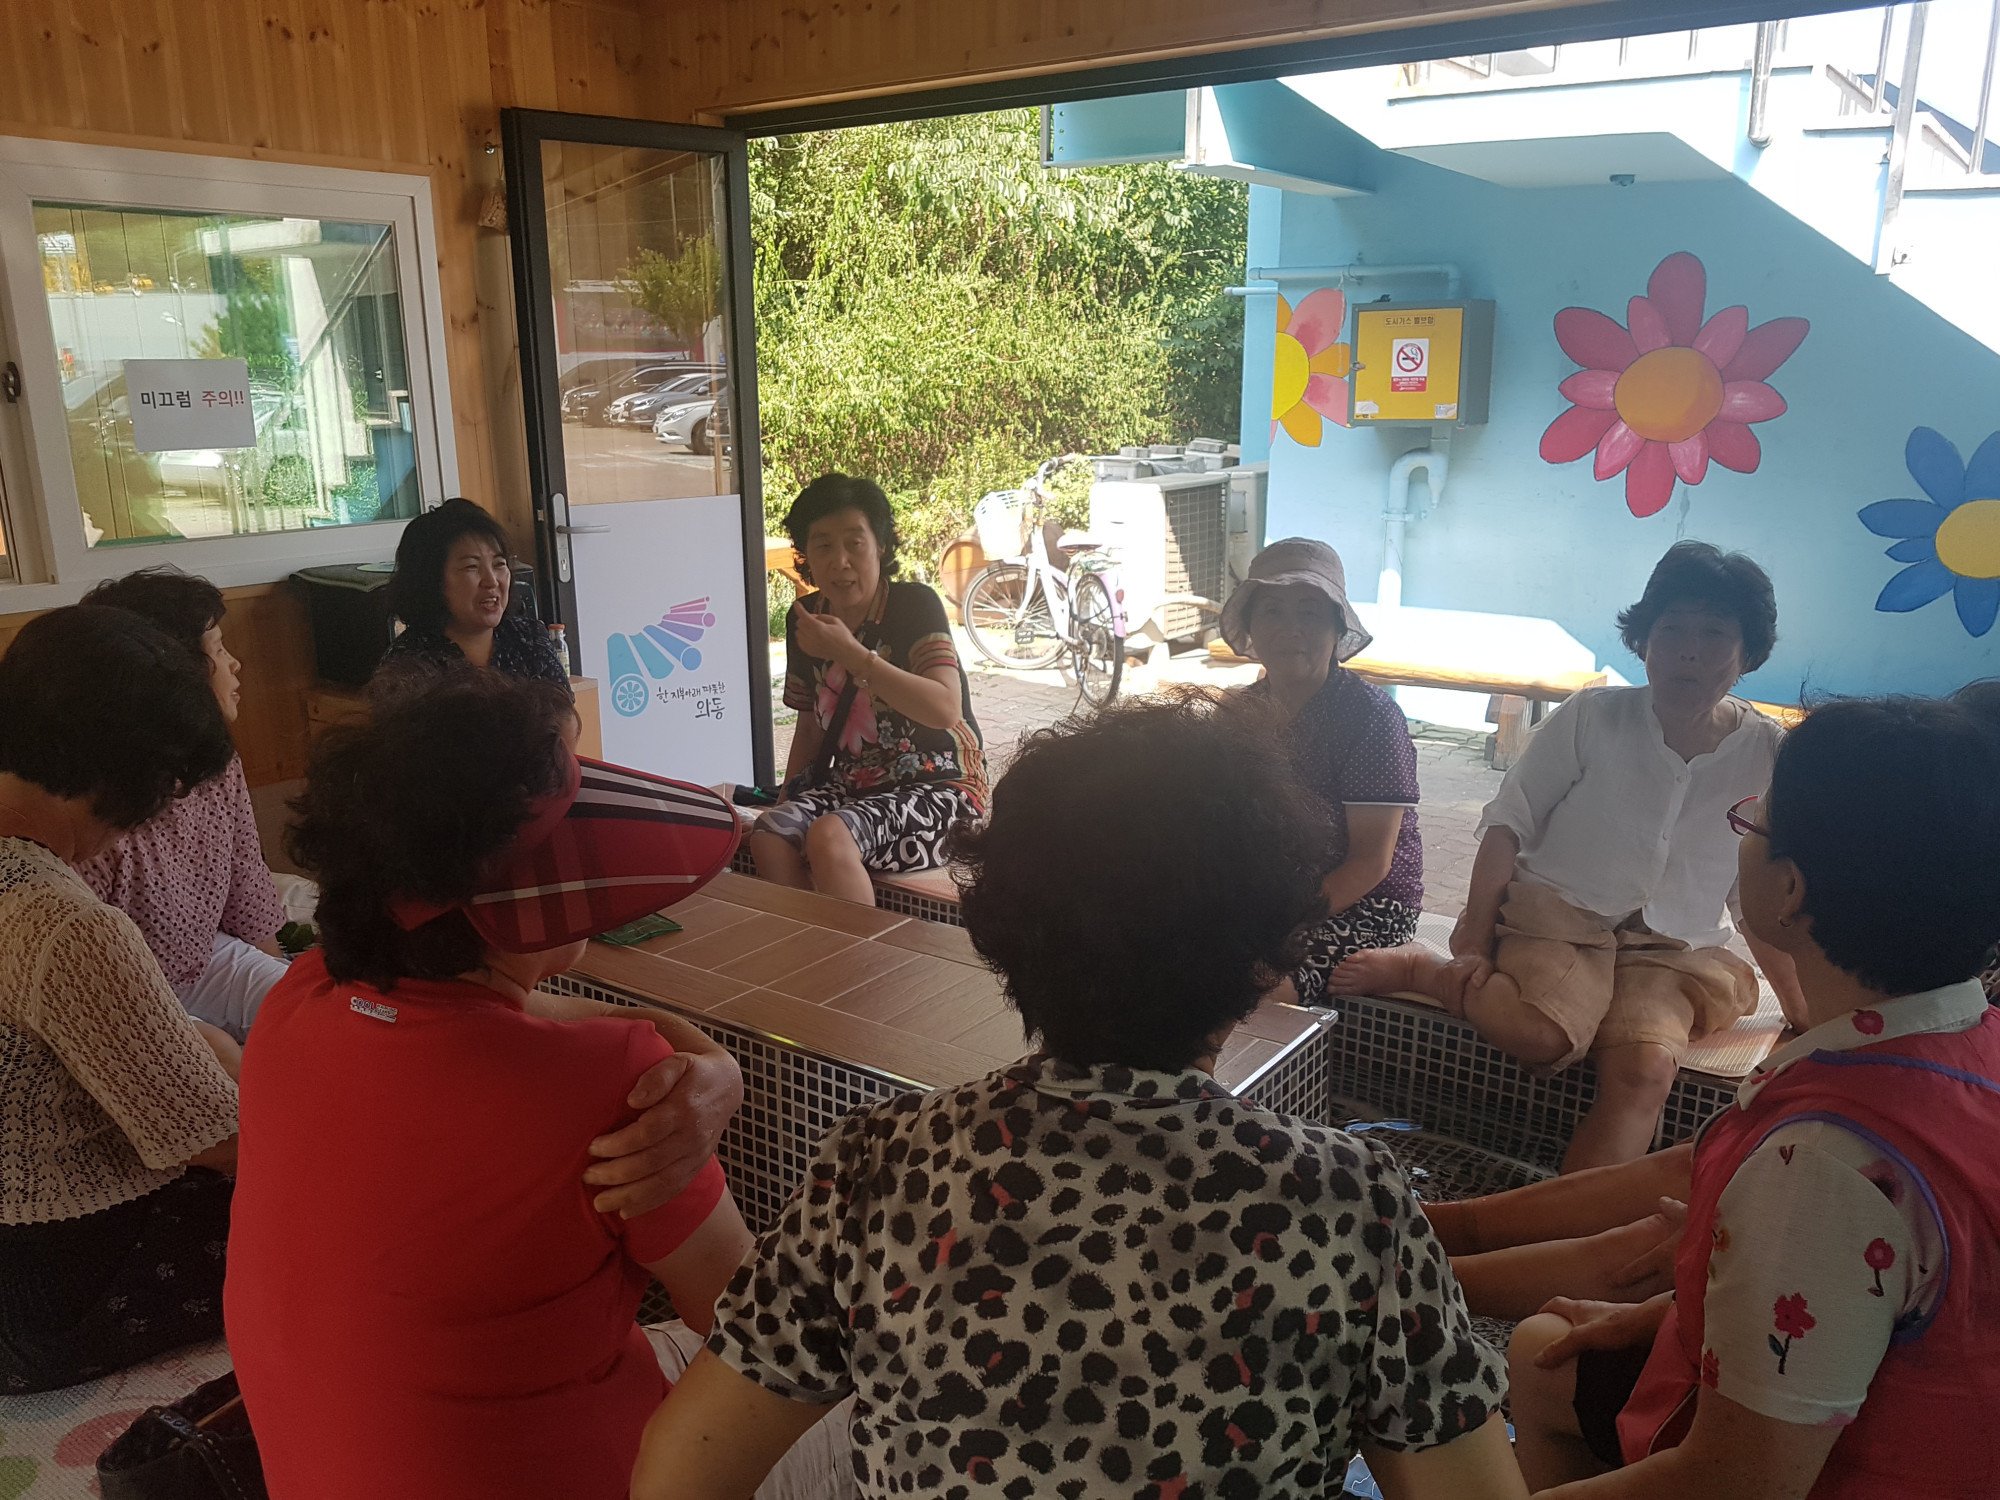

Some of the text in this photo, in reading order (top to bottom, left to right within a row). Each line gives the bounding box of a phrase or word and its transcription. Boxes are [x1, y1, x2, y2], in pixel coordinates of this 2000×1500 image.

[1385, 316, 1412, 326] 도시가스
[140, 389, 245, 409] 미끄럼 주의!!
[656, 686, 669, 704] 한
